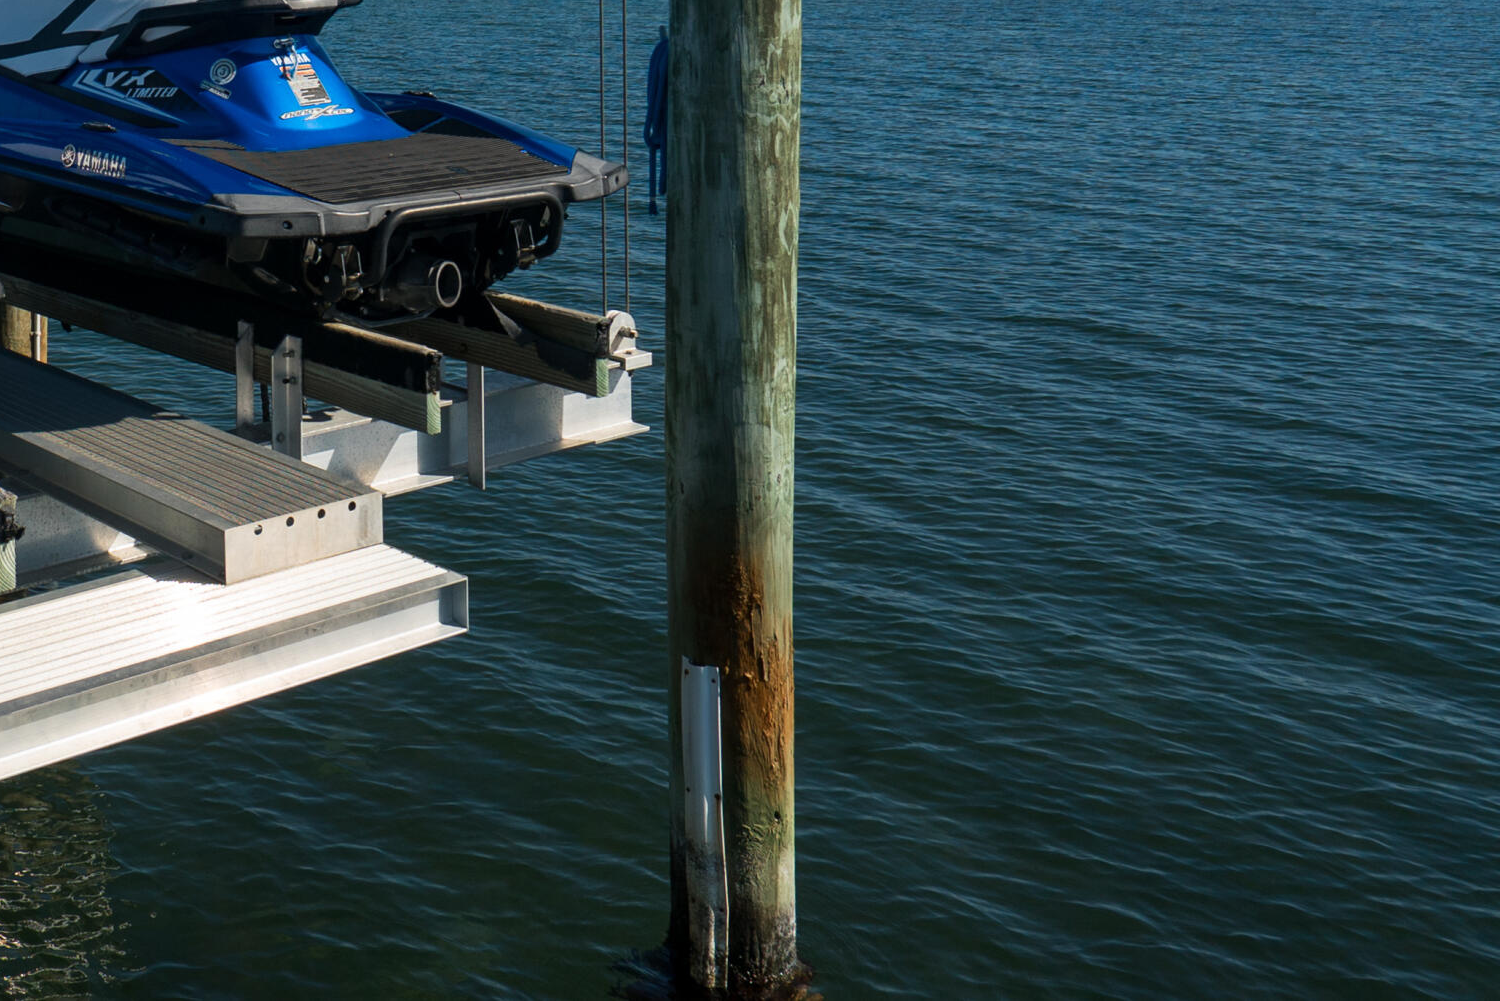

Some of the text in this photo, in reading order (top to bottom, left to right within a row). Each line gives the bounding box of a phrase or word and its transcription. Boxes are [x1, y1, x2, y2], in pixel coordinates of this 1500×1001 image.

[270, 53, 311, 66] YAMAHA
[105, 70, 155, 87] VX
[124, 87, 178, 98] LIMITED
[77, 150, 126, 178] YAMAHA
